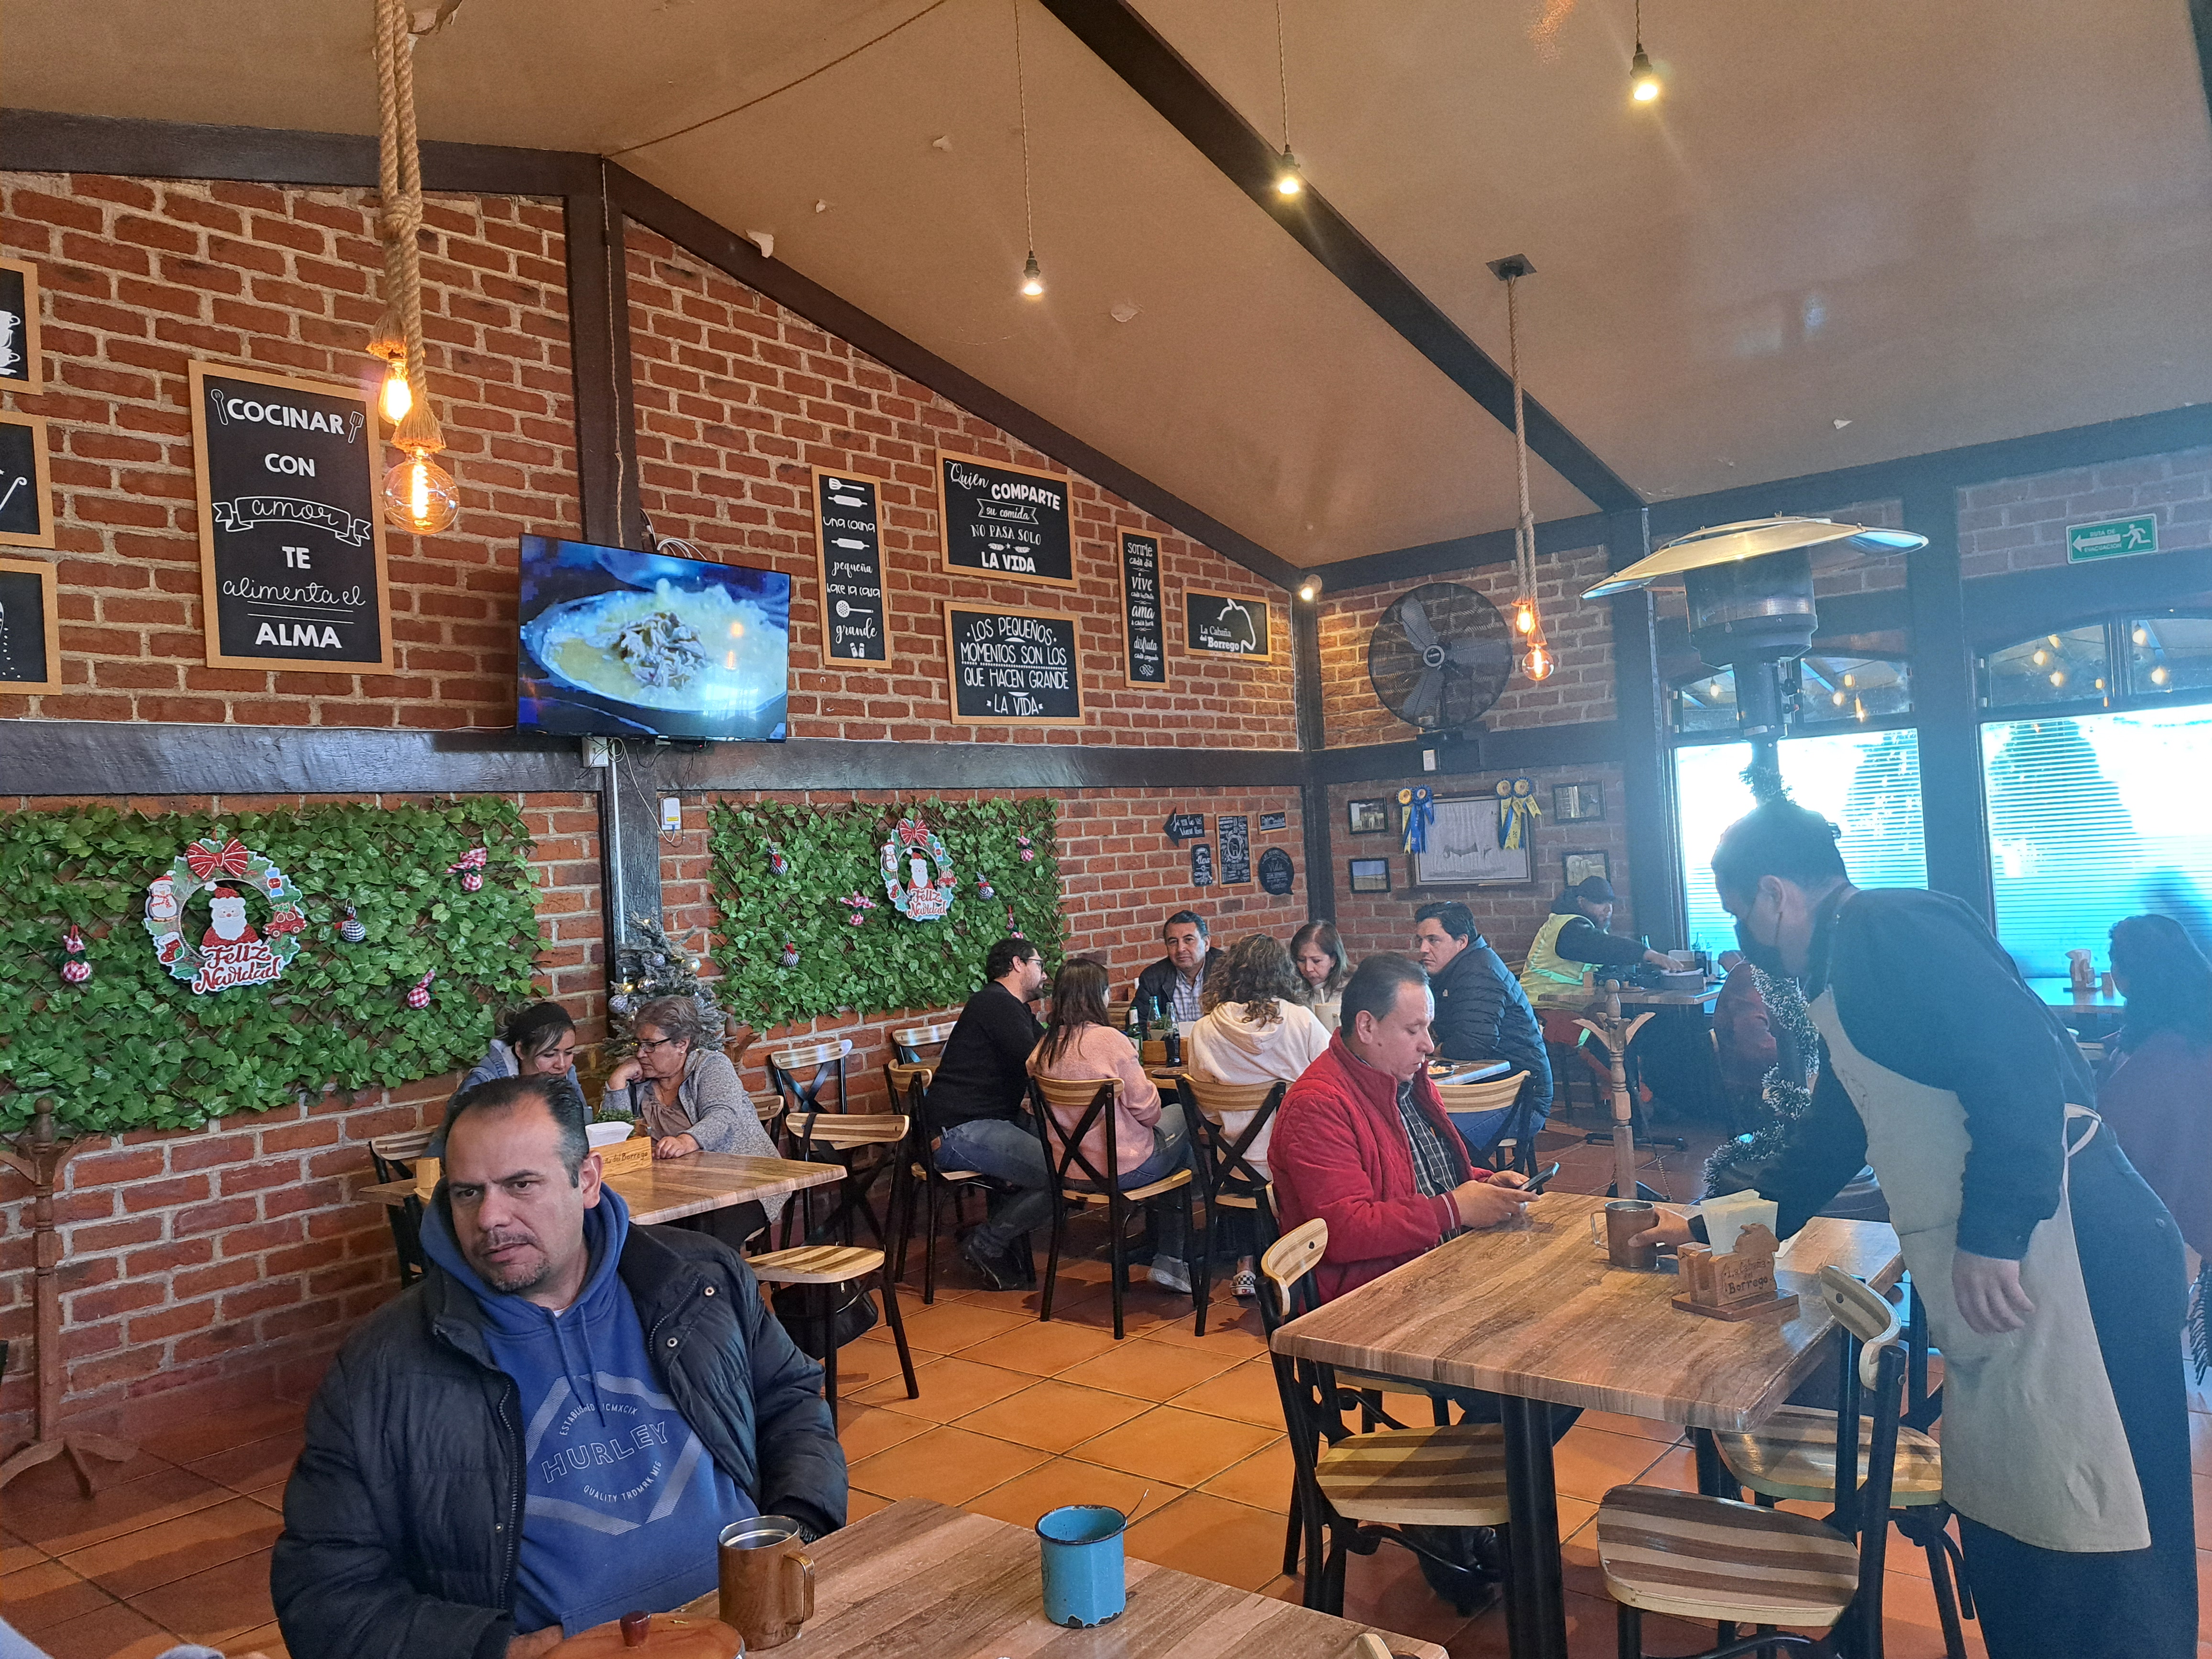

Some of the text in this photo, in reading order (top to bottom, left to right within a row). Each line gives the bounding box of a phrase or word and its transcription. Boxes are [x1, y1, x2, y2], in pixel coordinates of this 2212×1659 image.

[227, 398, 344, 434] COCINAR
[265, 453, 315, 477] CON
[945, 461, 1061, 510] Quien COMPARTE
[252, 500, 338, 525] amor
[823, 516, 845, 528] una
[986, 506, 1030, 520] su comida
[970, 525, 1041, 545] NO PASA SOLO
[282, 546, 310, 569] TE
[981, 552, 1036, 573] LA VIDA
[831, 561, 873, 578] pequeña
[223, 577, 366, 605] alimenta el
[827, 583, 880, 598] hace la casa
[1131, 572, 1152, 591] vive
[1131, 606, 1155, 619] ama
[255, 622, 342, 648] ALMA
[836, 618, 877, 644] grande
[971, 617, 1052, 646] LOS PEQUEÑOS
[1200, 624, 1231, 637] La Cabaña
[961, 642, 1067, 665] MOMENTOS SON LOS
[1134, 636, 1157, 653] disfruta
[1207, 636, 1239, 652] Borrego
[964, 667, 1069, 689] QUE HACEN GRANDE
[994, 694, 1039, 716] LA VIDA
[911, 889, 942, 903] Feliz
[907, 901, 947, 917] Navidad
[205, 944, 272, 969] Feliz
[194, 957, 282, 993] Navidad
[612, 1154, 620, 1163] del
[621, 1152, 648, 1161] Borrego
[1728, 1277, 1768, 1294] Borrego
[541, 1421, 668, 1483] HURLEY
[583, 1461, 661, 1502] QUALITY TRDMRK MFG
